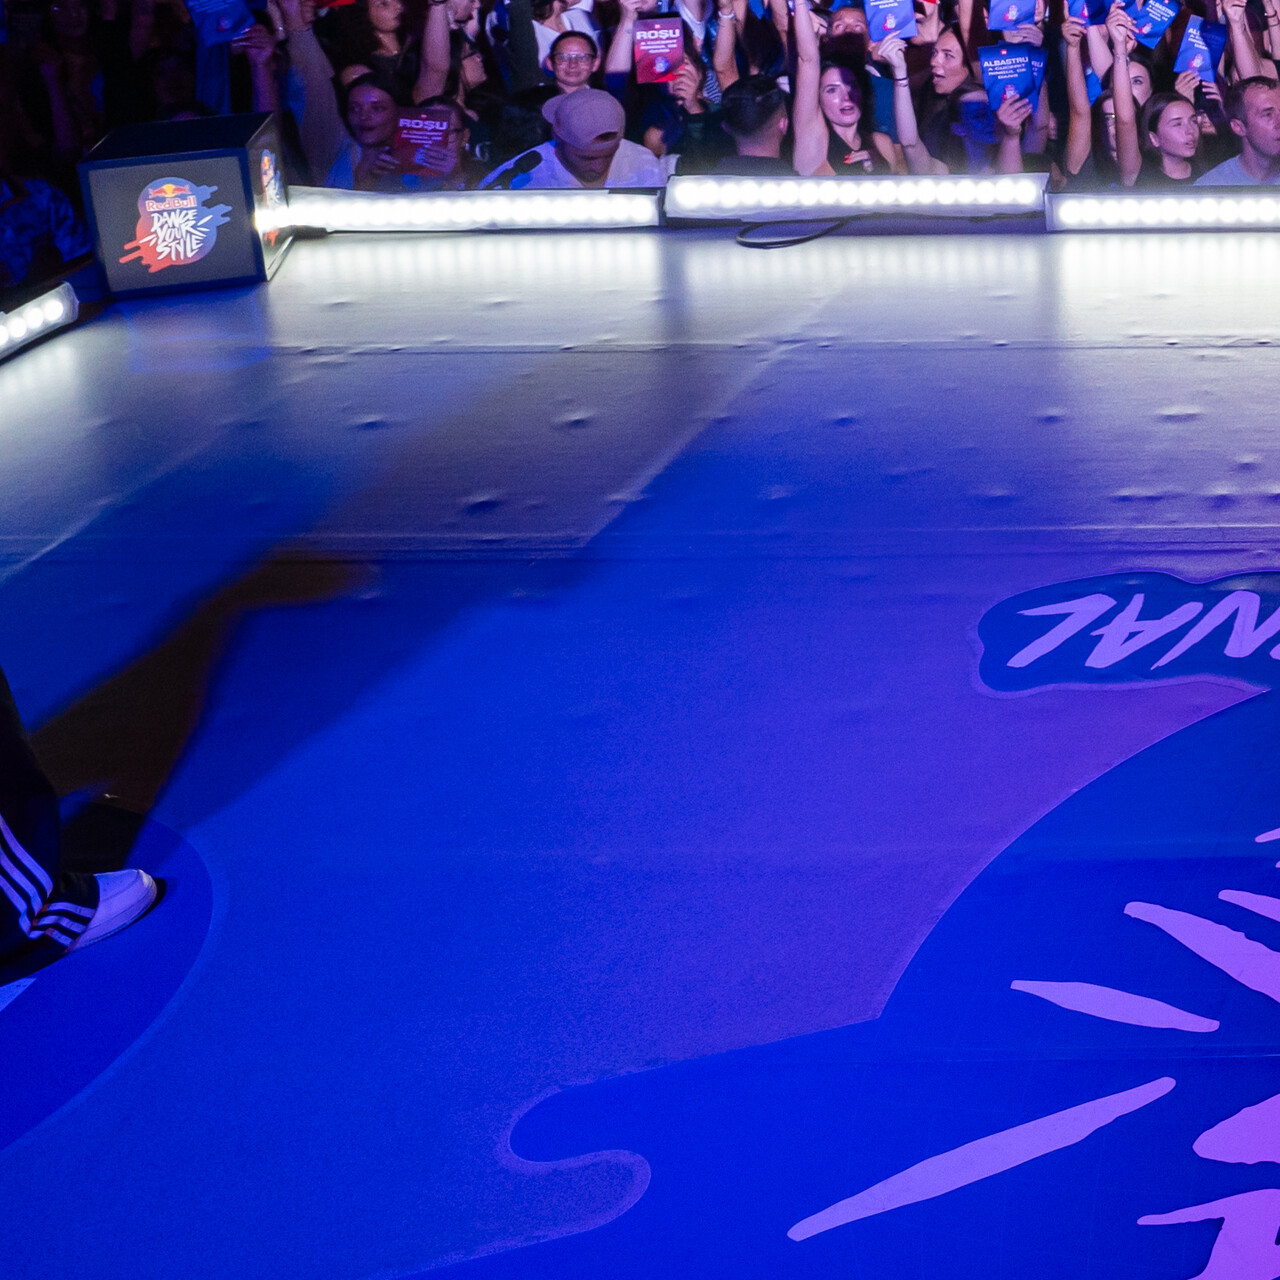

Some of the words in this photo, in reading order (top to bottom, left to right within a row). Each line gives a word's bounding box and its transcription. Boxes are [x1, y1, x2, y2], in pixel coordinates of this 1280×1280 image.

[637, 28, 681, 40] ROȘU
[984, 56, 1028, 68] ALBASTRU
[146, 199, 171, 211] Red
[173, 195, 197, 210] Bull
[150, 209, 198, 232] DANCE
[155, 220, 207, 243] YOUR
[156, 237, 202, 261] STYLE
